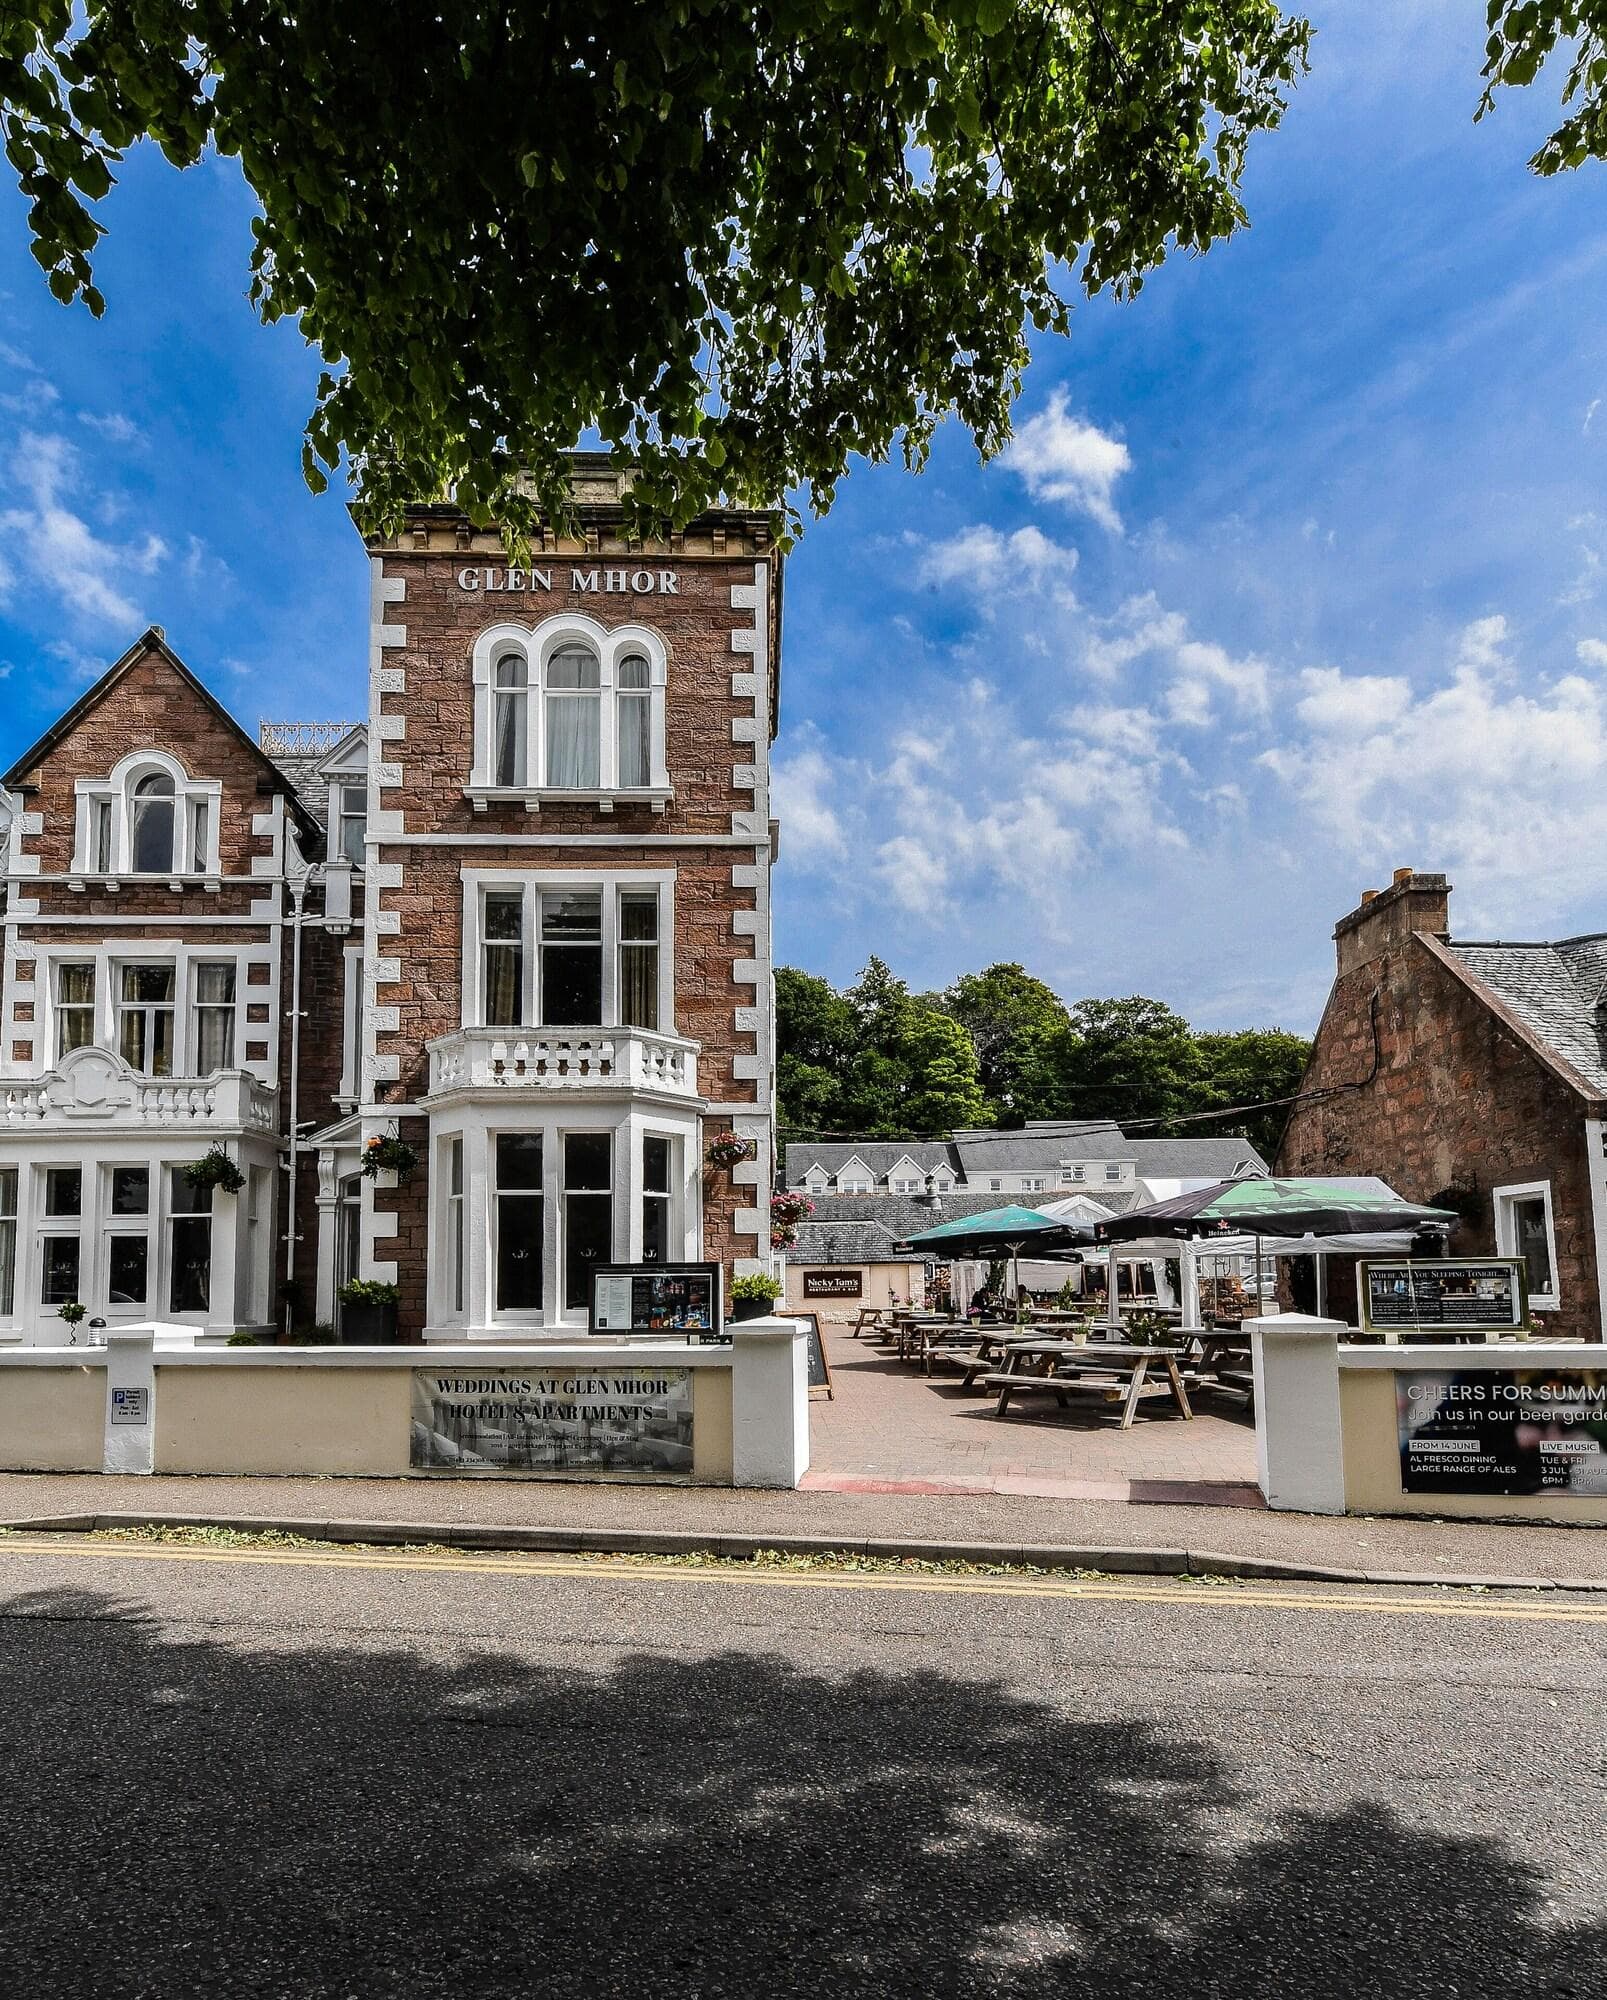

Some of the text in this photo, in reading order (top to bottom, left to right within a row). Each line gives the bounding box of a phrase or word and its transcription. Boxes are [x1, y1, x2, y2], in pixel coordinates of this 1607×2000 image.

[458, 568, 680, 594] GLEN MHOR
[808, 1278, 834, 1288] Nicky
[437, 1379, 669, 1396] WEDDINGS AT GLEN MHOR
[116, 1392, 124, 1402] P
[1407, 1385, 1606, 1401] CHEERS FOR SUMM
[450, 1404, 654, 1423] HOTEL & APARTMENTS
[1408, 1408, 1441, 1421] Join
[1446, 1410, 1465, 1421] us
[1468, 1408, 1484, 1421] in
[1487, 1410, 1515, 1421] our
[1520, 1408, 1558, 1422] beer
[1411, 1442, 1438, 1450] FROM
[1441, 1442, 1450, 1450] 14
[1542, 1443, 1563, 1451] LIVE
[1410, 1455, 1497, 1464] AL FRESCO DINING
[1541, 1456, 1586, 1465] TUE & FRI
[1411, 1465, 1441, 1473] LARGE
[1443, 1465, 1476, 1474] RANGE
[1492, 1466, 1517, 1474] ALES
[1541, 1466, 1547, 1474] 3
[1549, 1466, 1567, 1475] JUL
[1586, 1468, 1607, 1476] AUG
[1542, 1476, 1563, 1485] 6PM
[1571, 1477, 1595, 1486] 8PM
